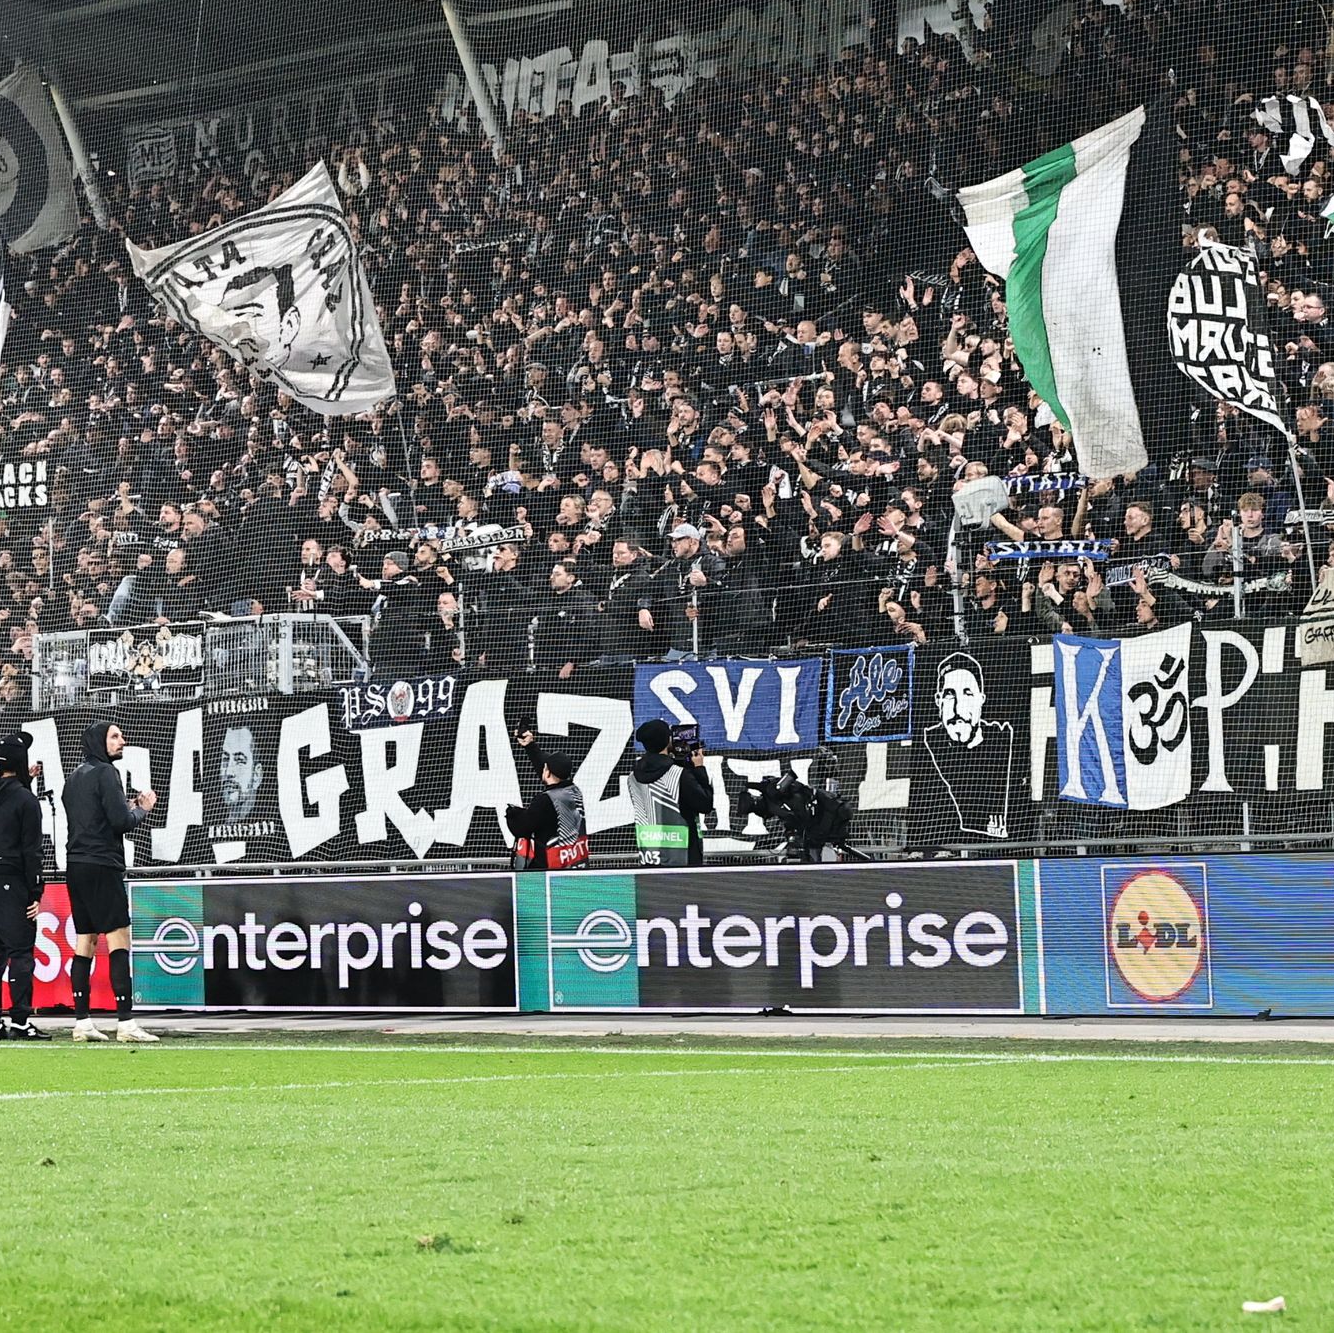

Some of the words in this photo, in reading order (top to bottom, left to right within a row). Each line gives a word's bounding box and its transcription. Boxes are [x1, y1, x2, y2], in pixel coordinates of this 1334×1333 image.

[649, 666, 801, 744] SVI
[277, 678, 636, 859] GRAZ
[640, 831, 684, 843] CHANNEL
[134, 901, 508, 990] enterprise
[552, 892, 1009, 989] enterprise
